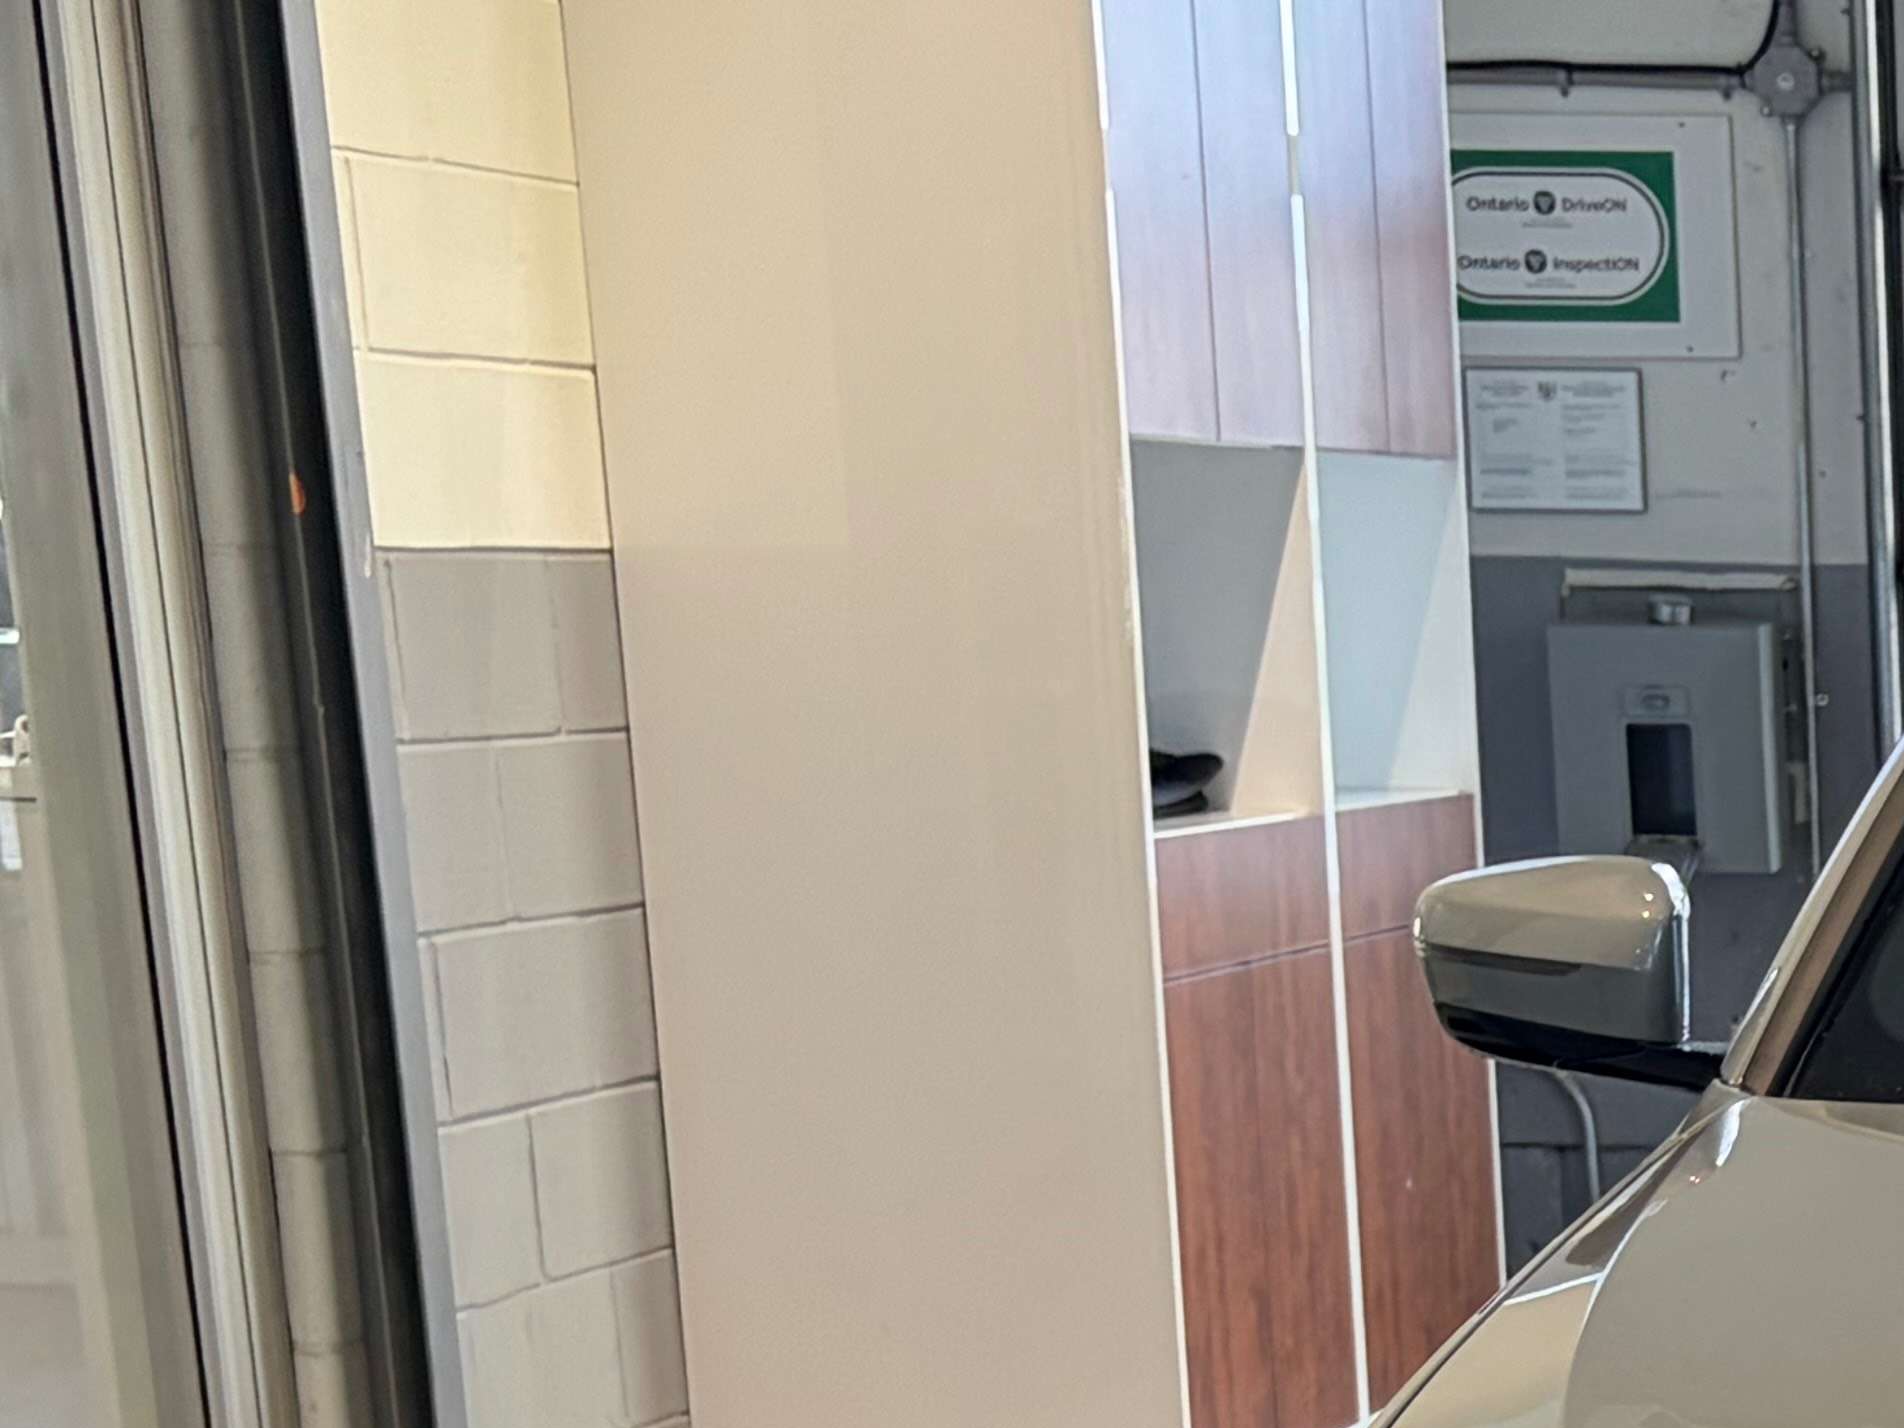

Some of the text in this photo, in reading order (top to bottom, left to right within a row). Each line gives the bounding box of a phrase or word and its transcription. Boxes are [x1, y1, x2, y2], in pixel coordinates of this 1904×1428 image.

[1466, 196, 1627, 213] Ontario DriveON
[1457, 255, 1521, 271] Ontario
